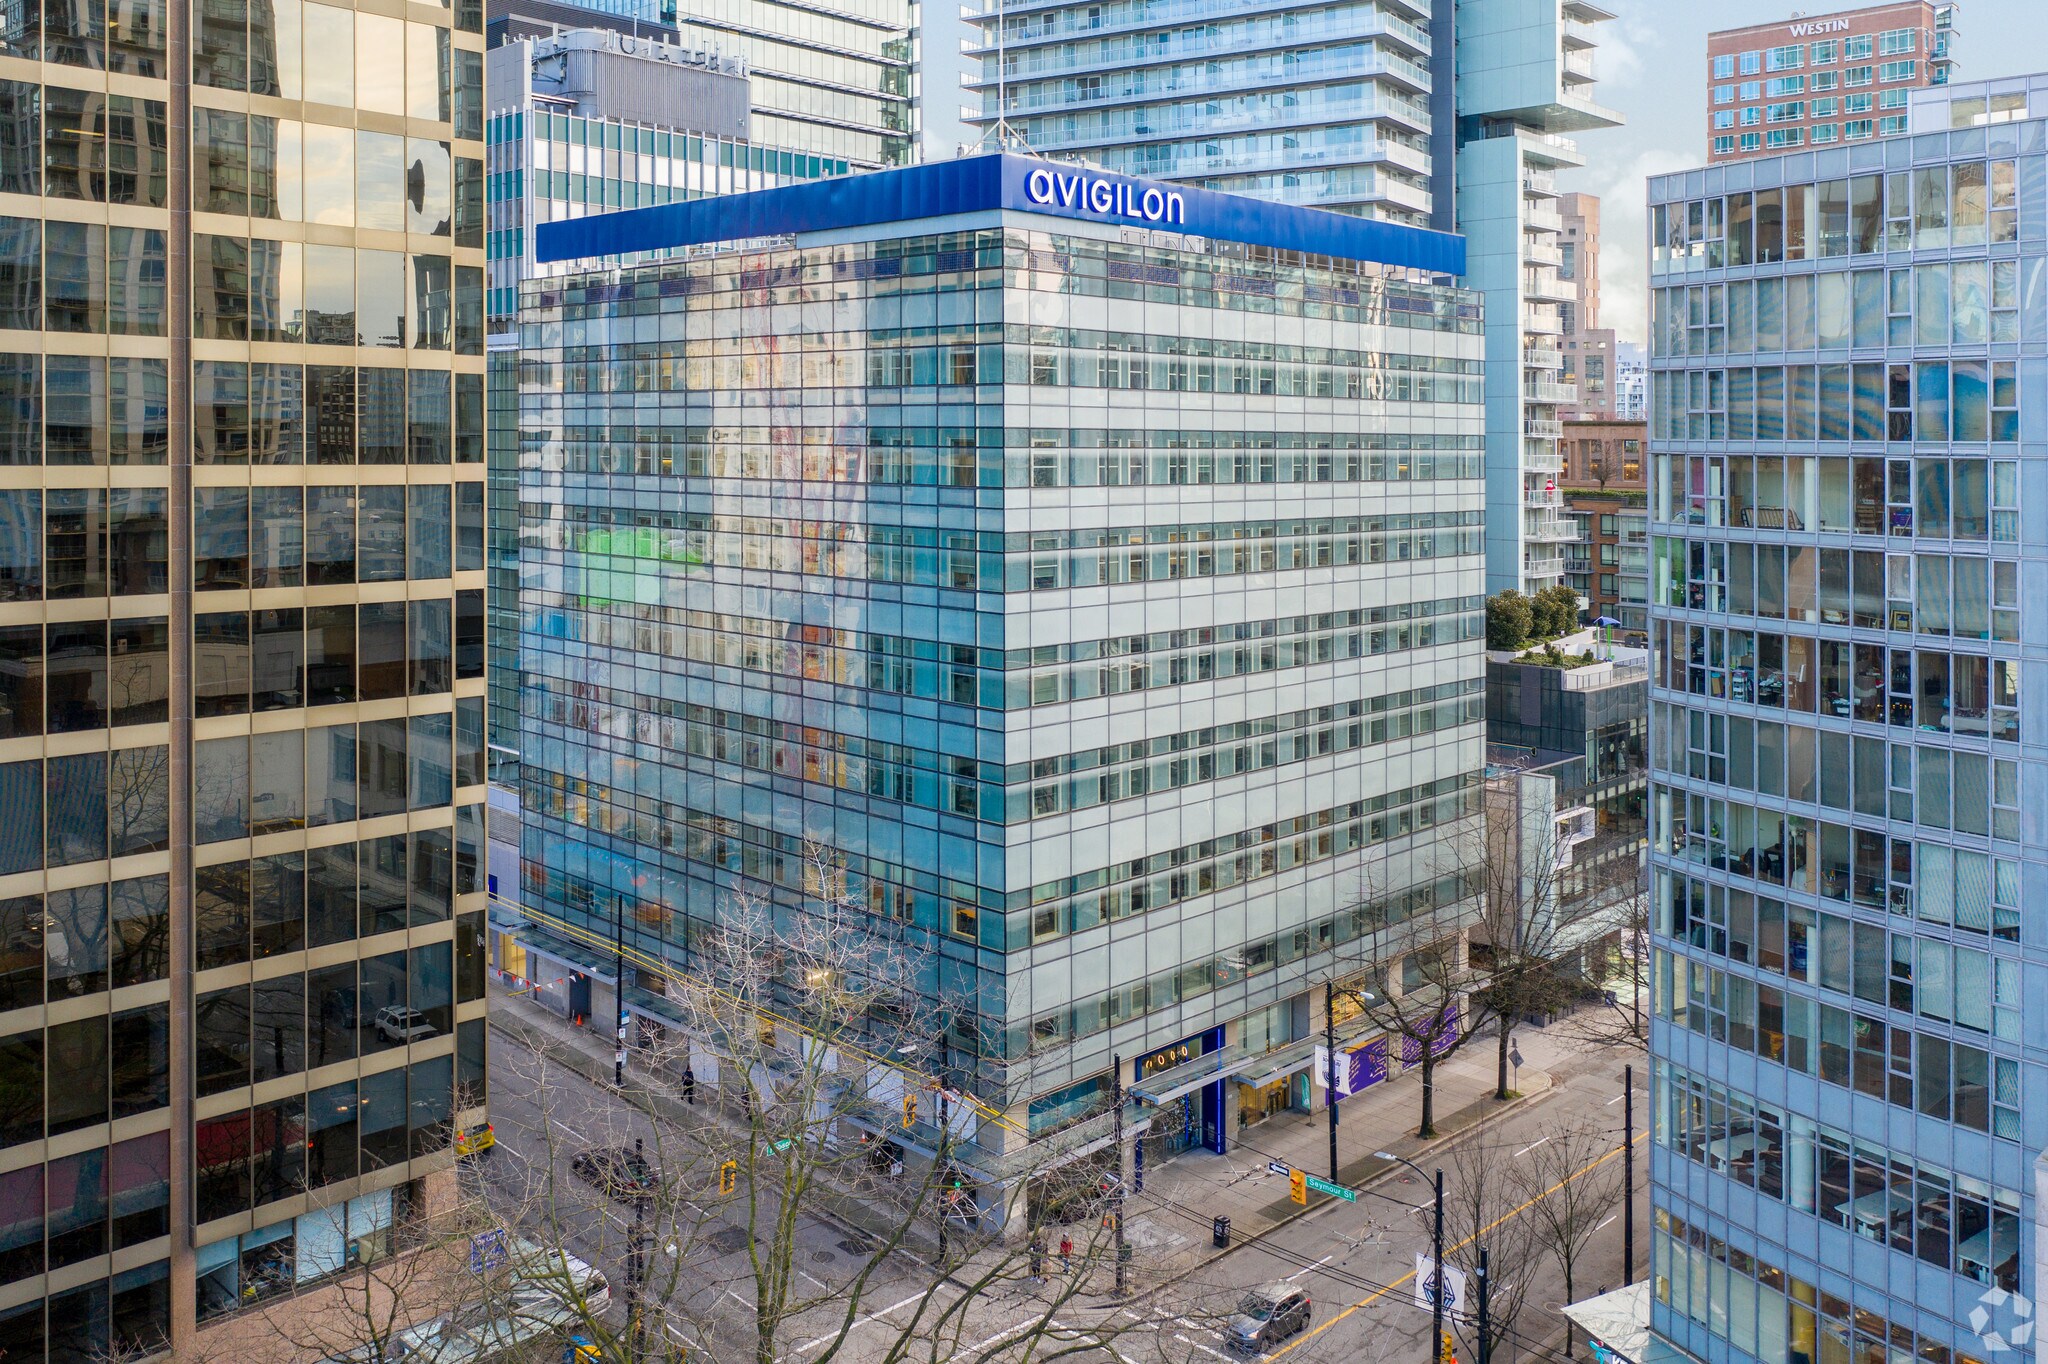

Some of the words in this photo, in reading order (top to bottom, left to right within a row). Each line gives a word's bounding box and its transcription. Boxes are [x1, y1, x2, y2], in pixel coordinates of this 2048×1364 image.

[1788, 19, 1849, 37] WESTIN
[1309, 1179, 1341, 1195] Seymour
[1343, 1190, 1352, 1199] St
